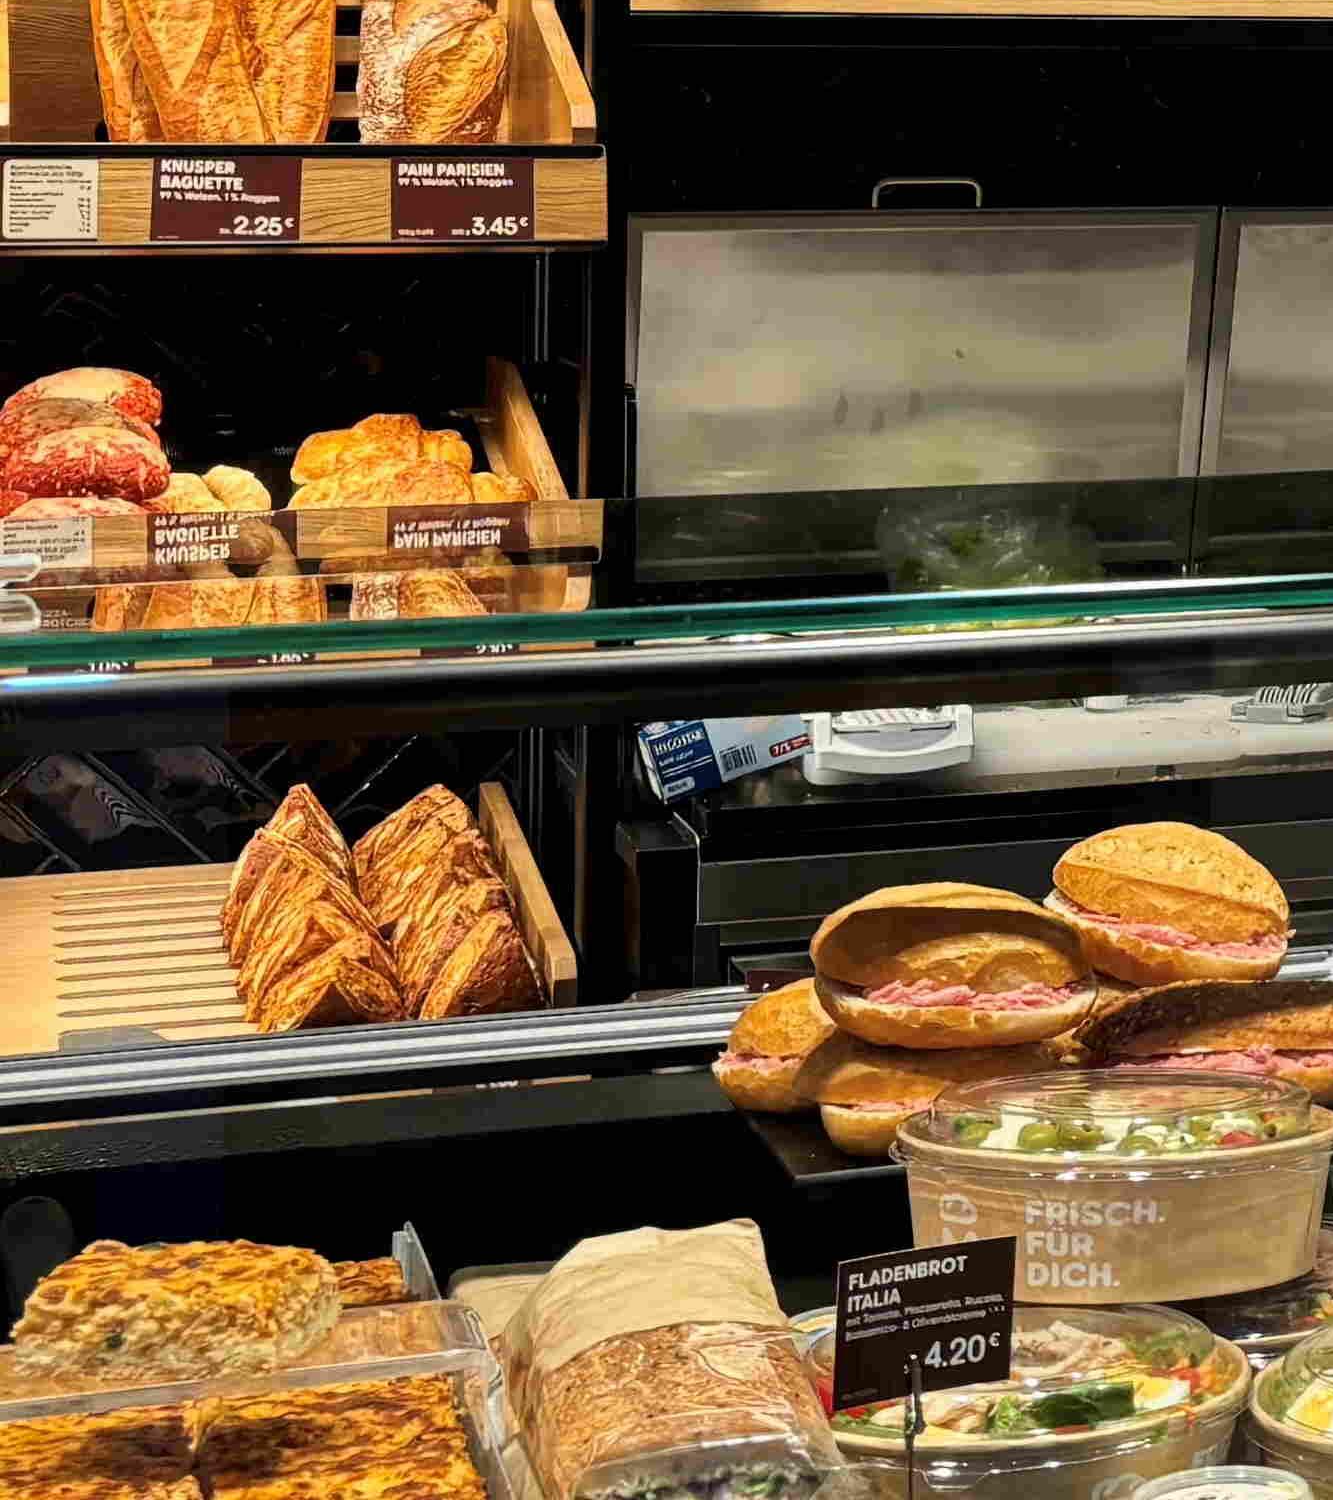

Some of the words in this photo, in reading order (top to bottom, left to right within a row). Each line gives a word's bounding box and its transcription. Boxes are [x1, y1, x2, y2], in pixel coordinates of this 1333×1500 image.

[160, 160, 236, 174] KNUSPER
[399, 163, 433, 176] PAIN
[437, 163, 504, 176] PARISIEN
[160, 176, 244, 191] BAGUETTE
[232, 216, 294, 236] 2.25€
[472, 216, 529, 236] 3.45€
[1024, 1196, 1166, 1229] FRISCH.
[1026, 1224, 1094, 1259] FÜR
[849, 1256, 968, 1290] FLADENBROT
[1026, 1262, 1121, 1289] DICH.
[848, 1288, 901, 1313] ITALIA
[925, 1332, 1000, 1368] 4.20€
